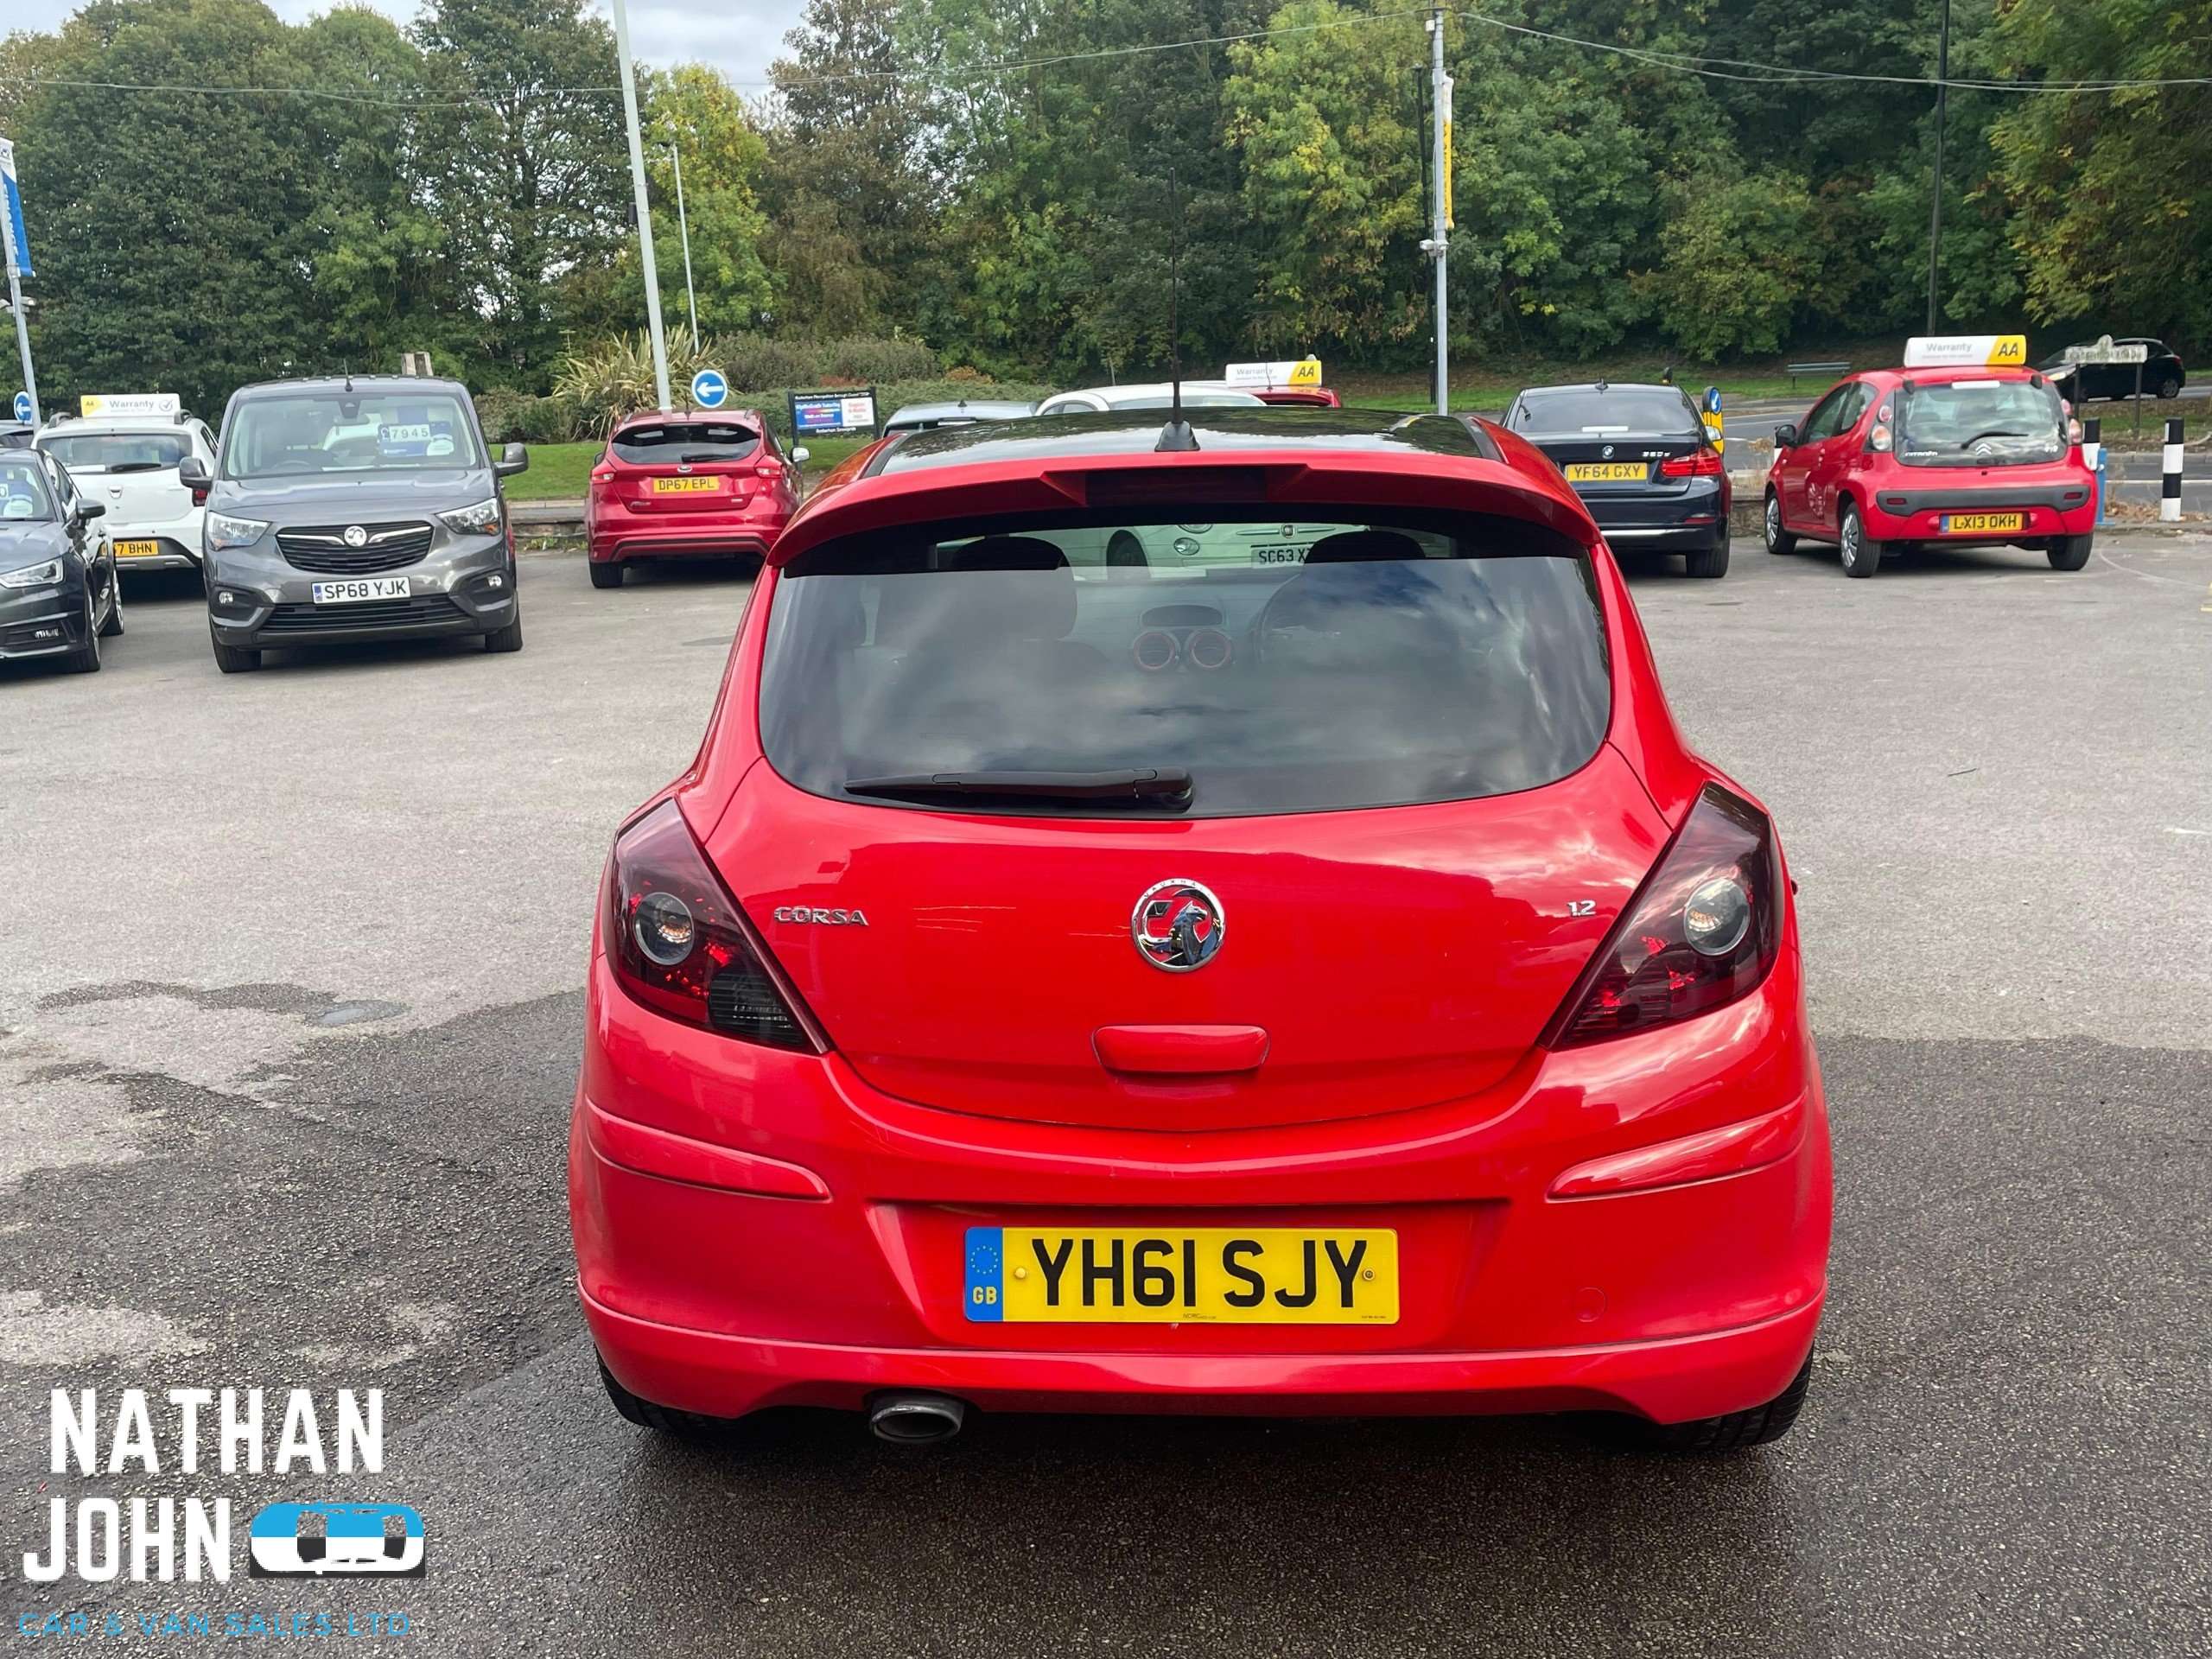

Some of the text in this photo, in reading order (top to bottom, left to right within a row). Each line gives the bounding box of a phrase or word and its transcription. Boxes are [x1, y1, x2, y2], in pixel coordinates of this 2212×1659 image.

[1926, 343, 1972, 352] Warranty
[1998, 342, 2018, 357] AA
[1298, 365, 1313, 378] AA
[109, 399, 154, 409] Warranty
[1574, 465, 1640, 478] YF64 GXY
[658, 478, 715, 490] DP67 EPL
[129, 543, 153, 554] BHN
[1258, 547, 1311, 564] SC63 X
[324, 580, 407, 599] SP68 YJK
[774, 906, 868, 926] CORSA
[1032, 1239, 1368, 1308] YH61 SJY
[973, 1286, 997, 1305] GB
